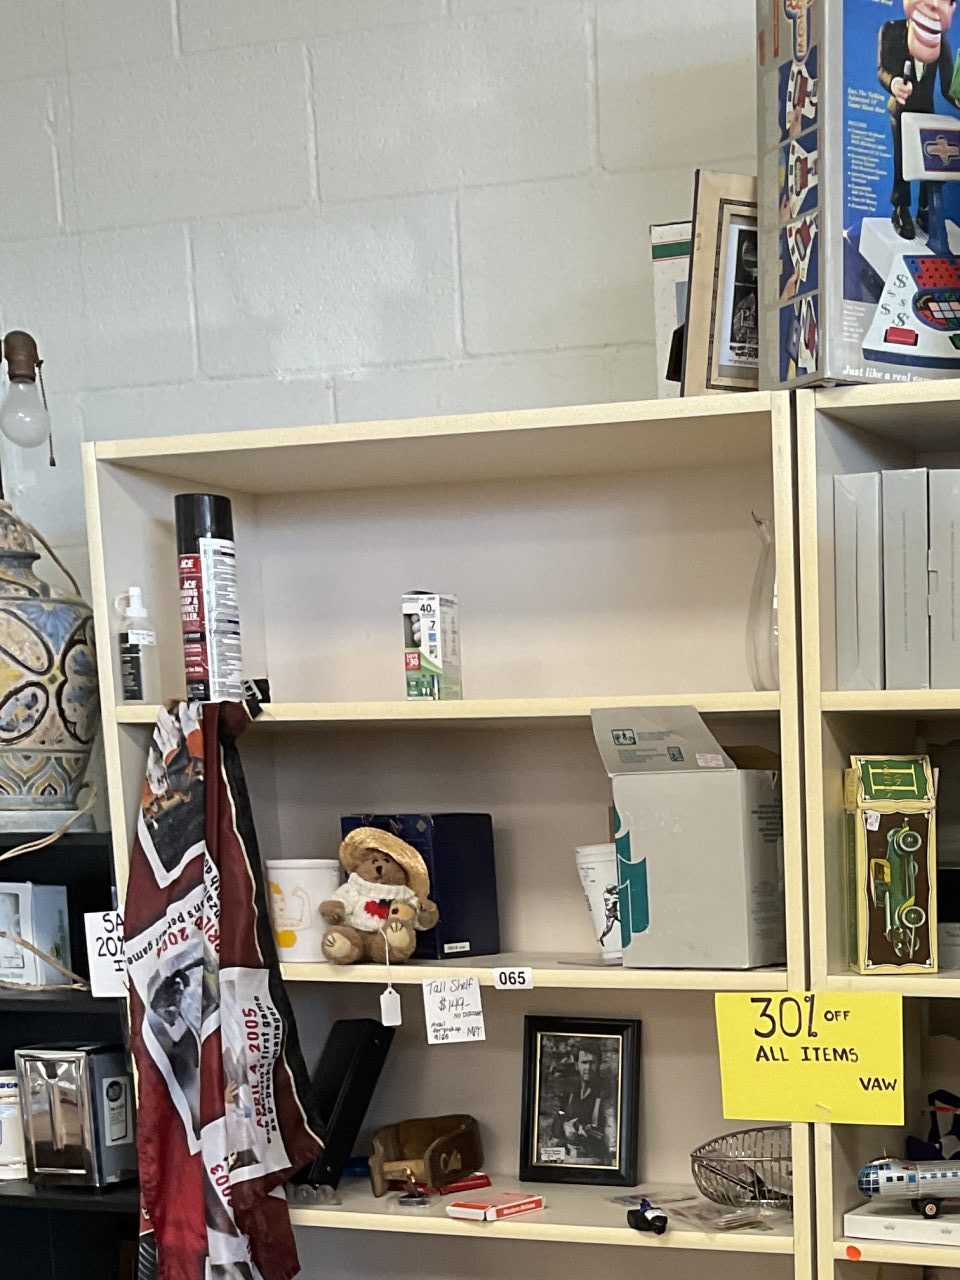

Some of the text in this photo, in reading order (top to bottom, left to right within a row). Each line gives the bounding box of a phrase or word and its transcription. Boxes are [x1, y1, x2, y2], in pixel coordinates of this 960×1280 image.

[865, 367, 882, 379] like
[499, 972, 526, 985] 065
[750, 994, 851, 1039] 30% OFF
[242, 1008, 258, 1054] 2005
[755, 1045, 859, 1064] ALL ITEMS
[859, 1077, 898, 1093] VAW
